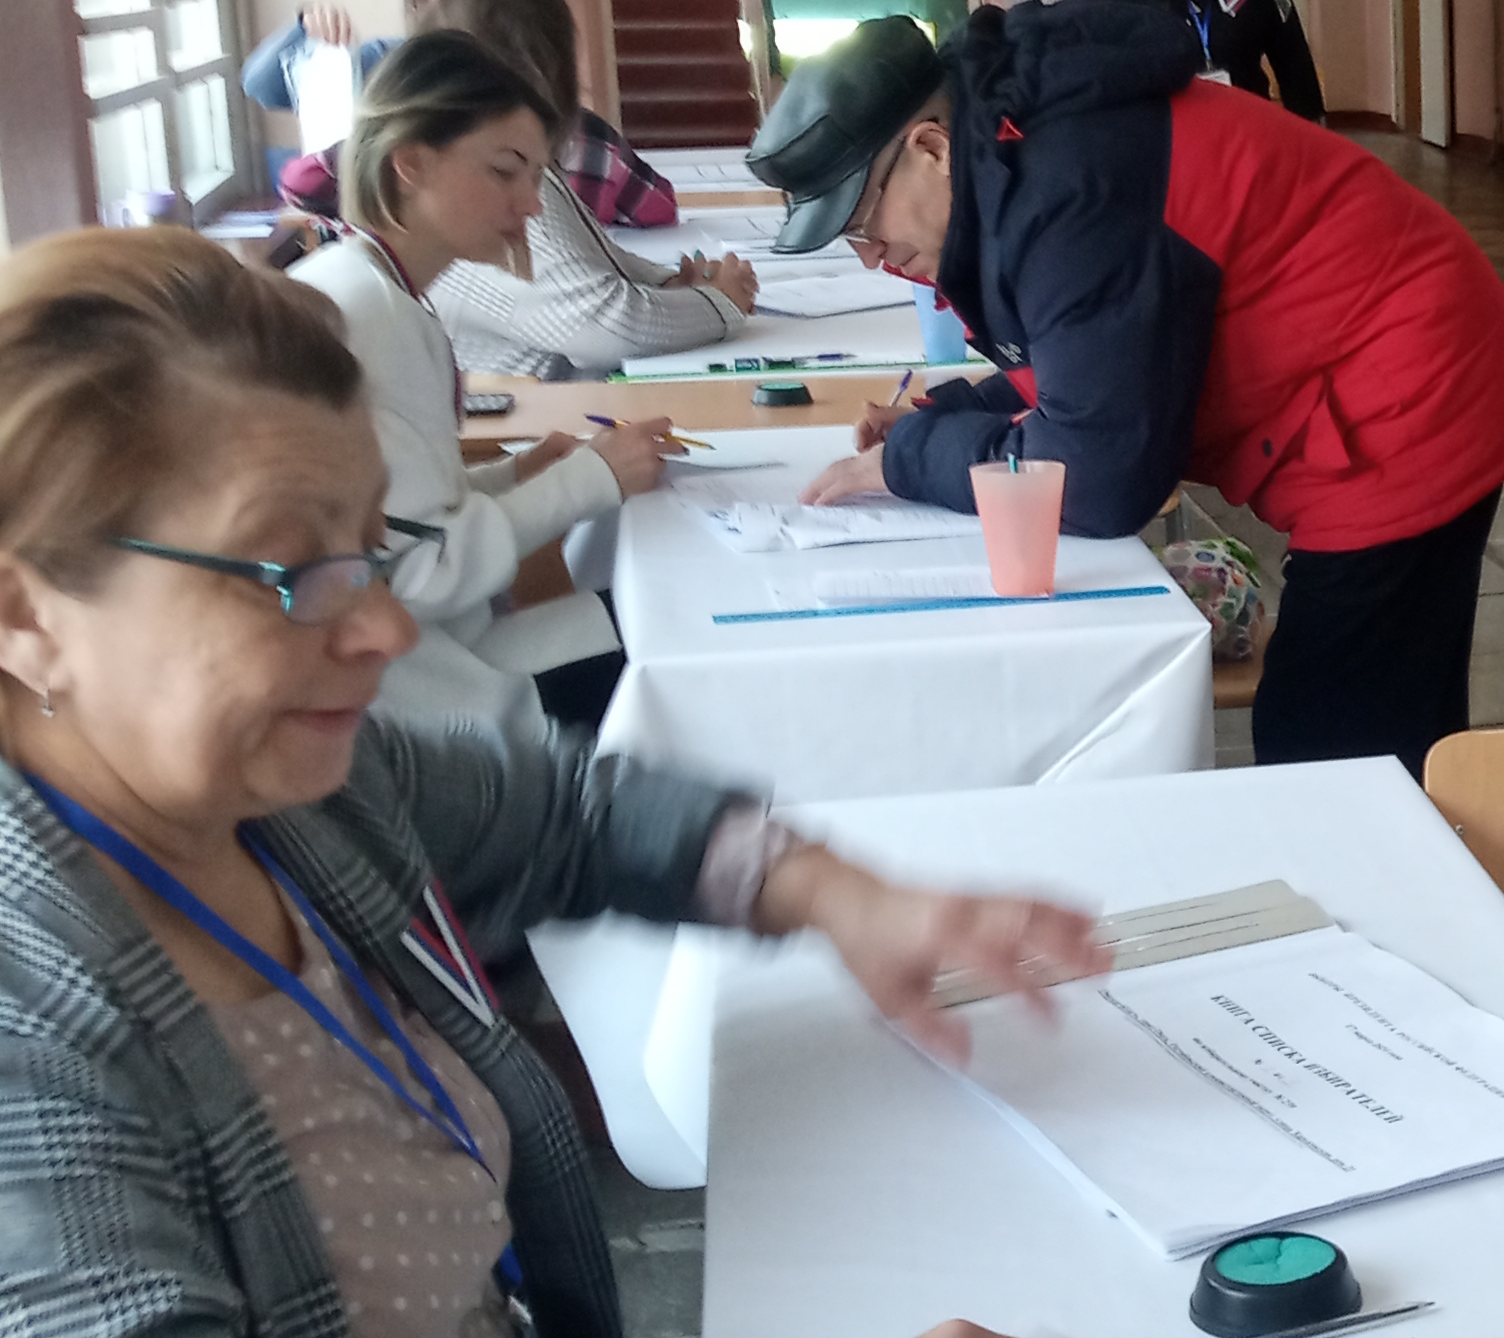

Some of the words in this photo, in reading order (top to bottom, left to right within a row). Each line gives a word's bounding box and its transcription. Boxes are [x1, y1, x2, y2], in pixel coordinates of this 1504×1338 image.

[1210, 994, 1255, 1026] КНИГА
[1251, 1024, 1306, 1065] СПИСКА
[1303, 1062, 1405, 1125] ИЗБИРАТЕЛЕЙ
